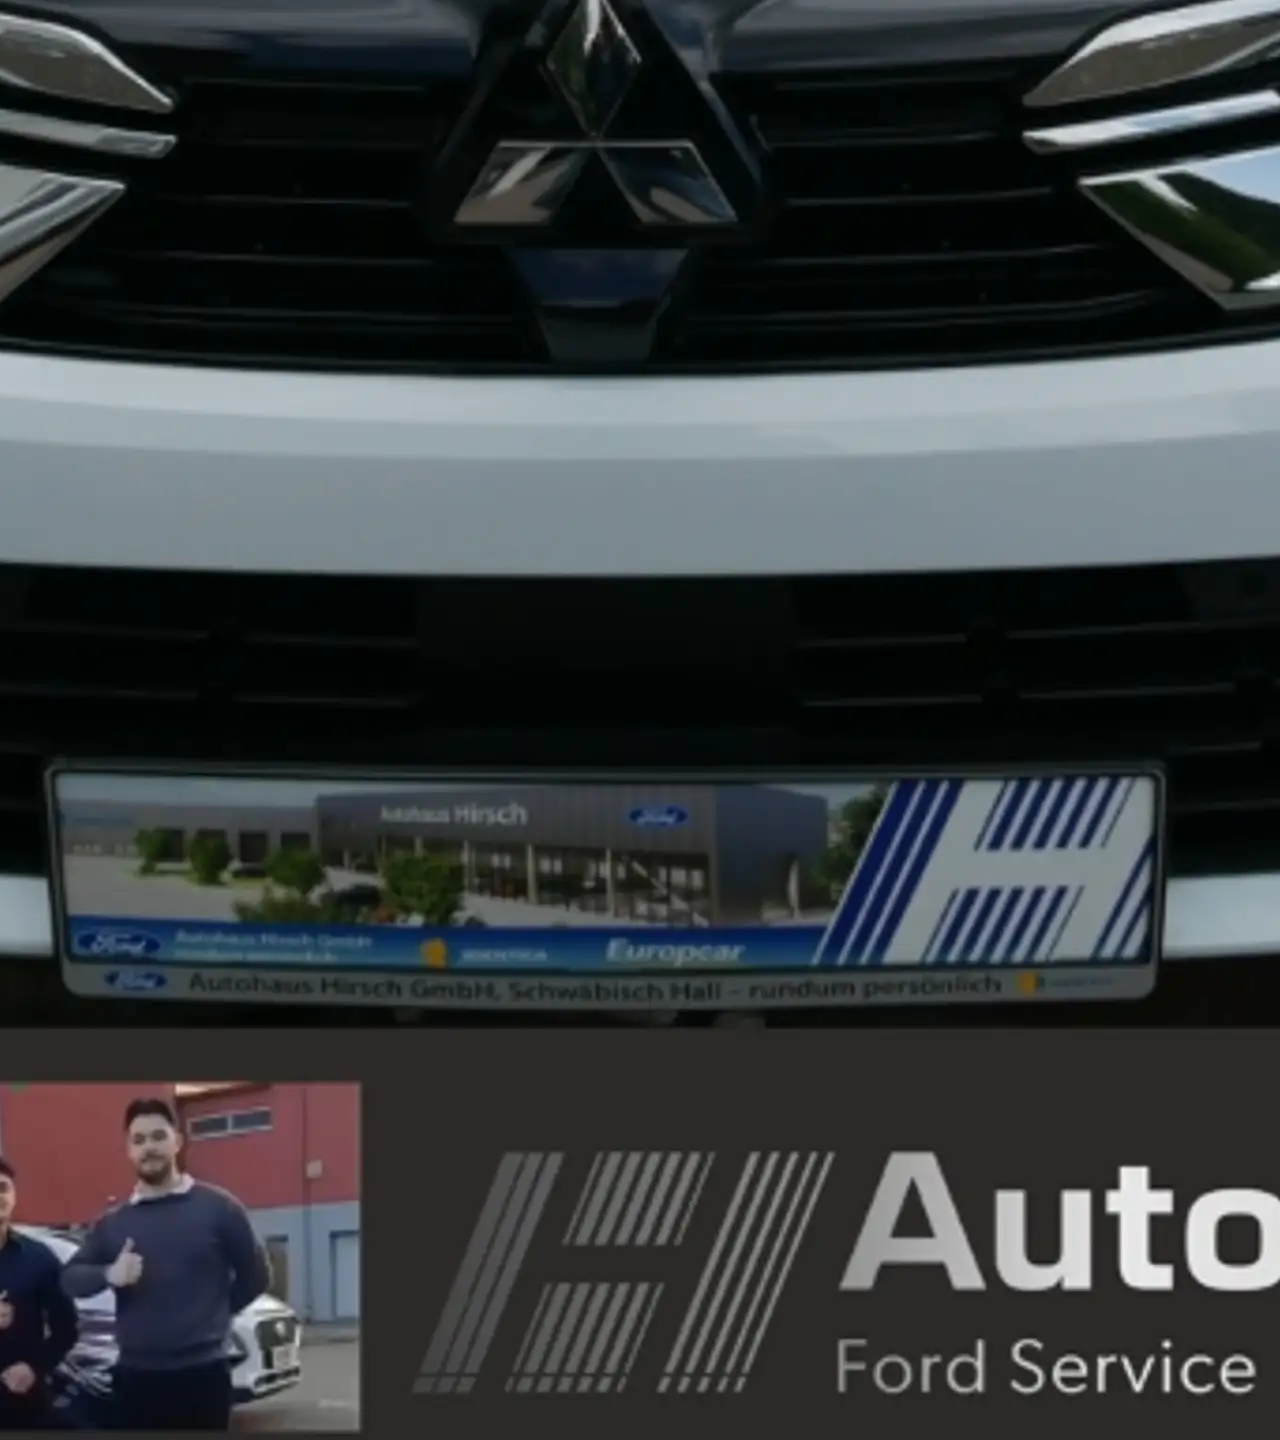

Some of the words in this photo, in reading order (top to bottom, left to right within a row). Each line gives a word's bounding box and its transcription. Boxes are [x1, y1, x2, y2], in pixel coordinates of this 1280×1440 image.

[454, 798, 529, 827] Hirsch
[606, 937, 747, 968] Europcar
[188, 972, 314, 995] Autohaus
[321, 975, 402, 998] Hirsch
[671, 980, 721, 1002] Hall
[749, 979, 856, 1001] rundum
